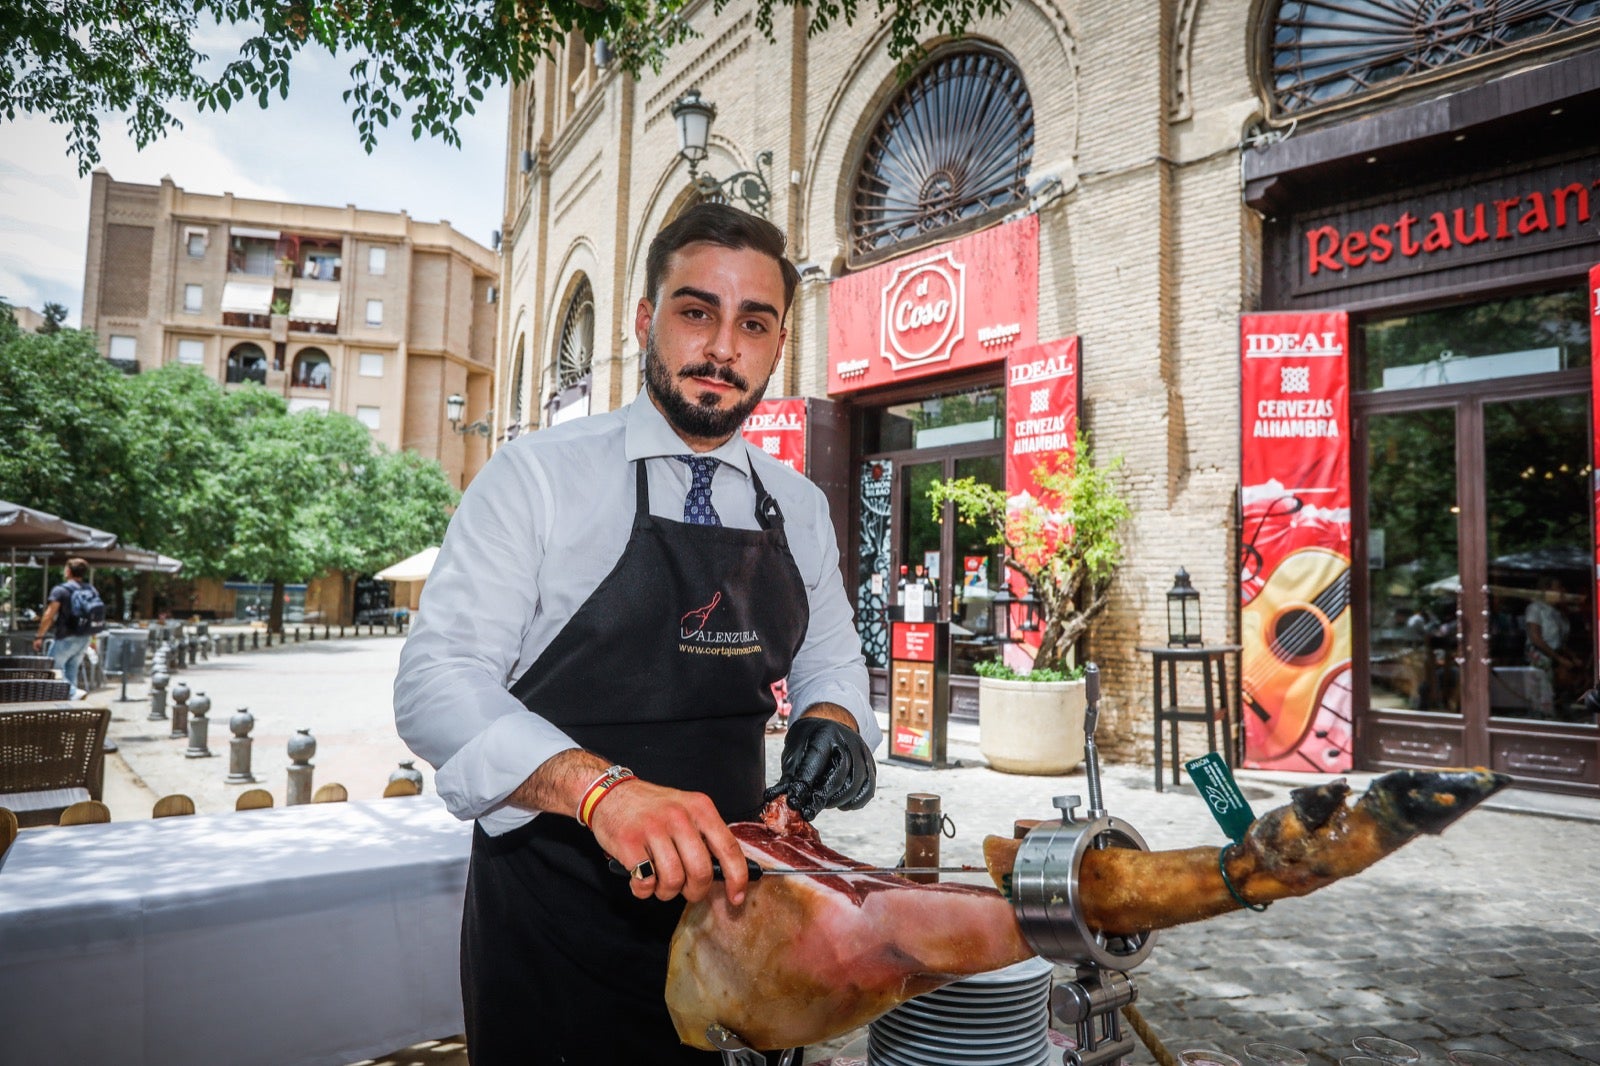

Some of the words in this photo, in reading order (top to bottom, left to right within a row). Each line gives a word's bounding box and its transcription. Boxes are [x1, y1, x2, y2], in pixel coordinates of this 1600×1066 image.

[1306, 178, 1600, 275] Restauran
[916, 277, 928, 297] el
[896, 300, 950, 332] Coso
[1246, 332, 1343, 353] IDEAL
[1010, 355, 1073, 380] IDEAL
[1258, 399, 1334, 417] CERVEZAS
[743, 413, 802, 428] IDEAL
[1015, 416, 1066, 436] CERVEZAS
[1253, 418, 1339, 438] ALHAMBRA
[1013, 432, 1068, 455] ALHAMBRA
